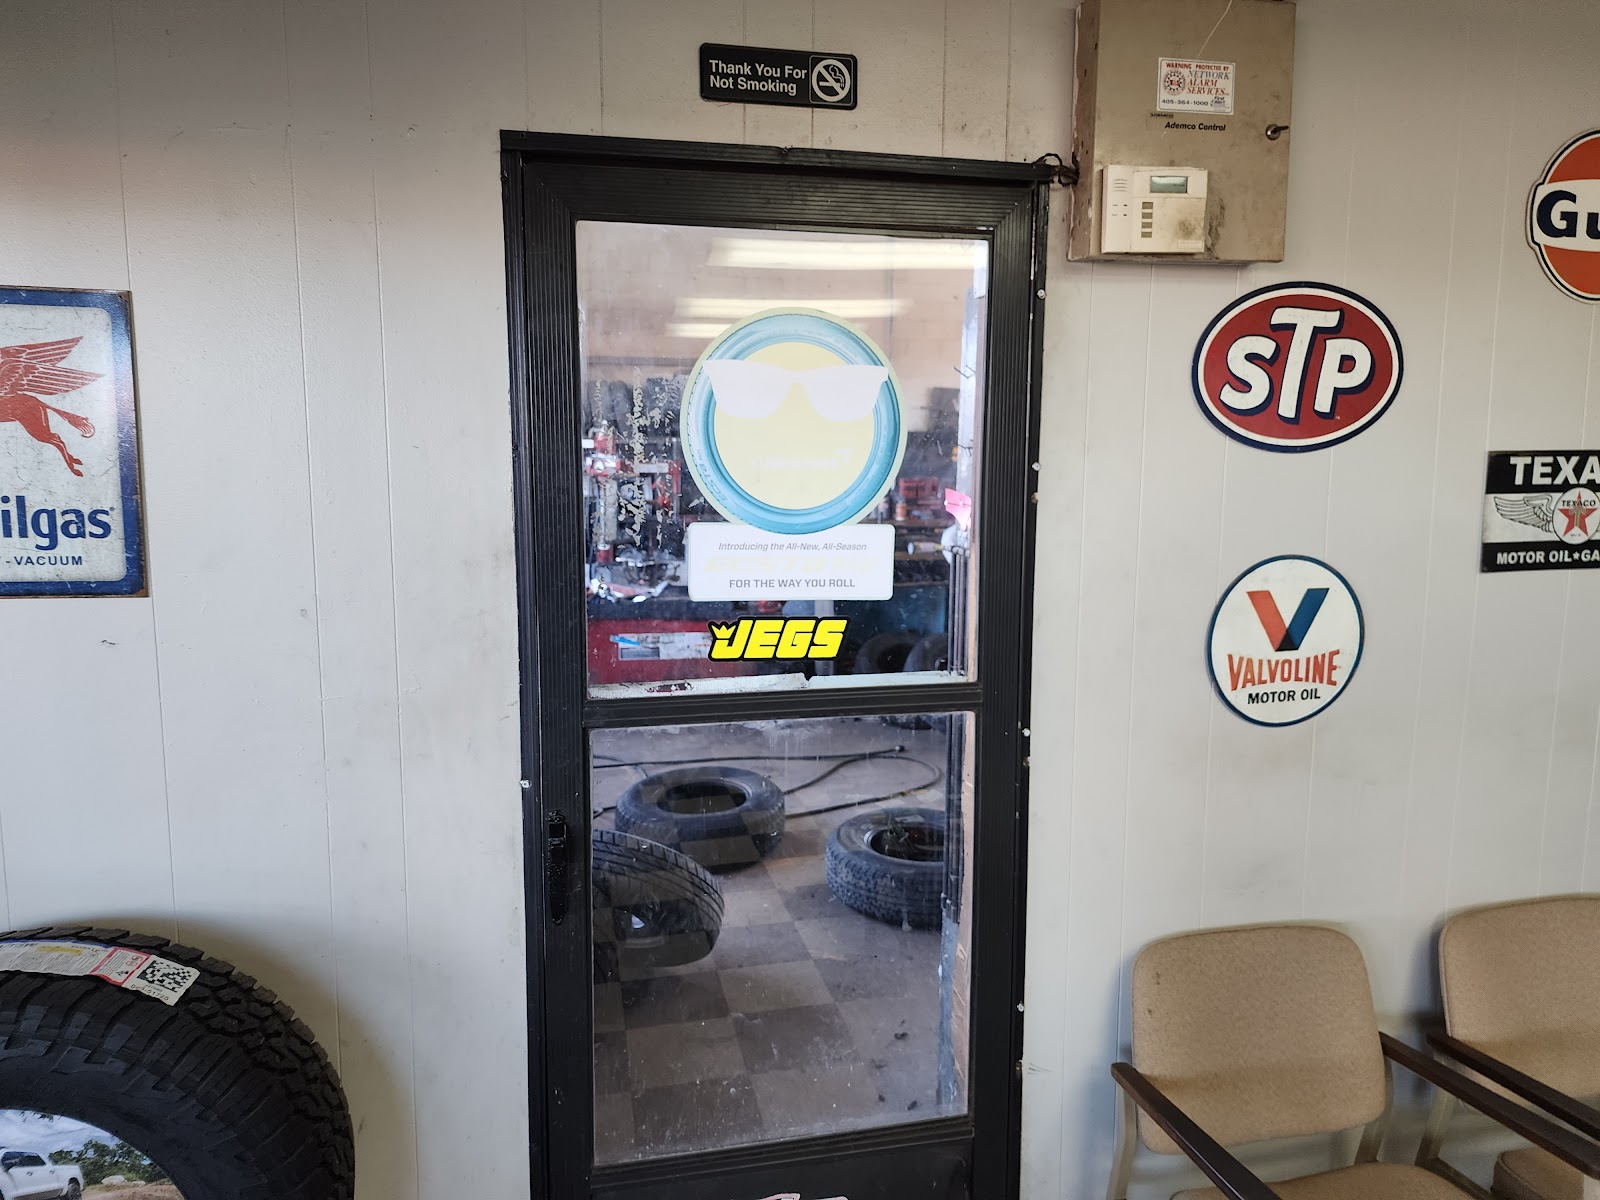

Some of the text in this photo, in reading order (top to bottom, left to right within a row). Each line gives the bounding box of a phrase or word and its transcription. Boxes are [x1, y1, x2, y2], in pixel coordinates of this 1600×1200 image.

[709, 59, 808, 79] Thank You For
[1187, 70, 1231, 80] NETWORK
[709, 74, 797, 97] Not Smoking
[1186, 79, 1218, 87] ALARM
[1186, 86, 1226, 96] SERVICES
[1164, 121, 1226, 131] Ademco Control
[1219, 306, 1375, 425] STP
[1509, 455, 1600, 486] TEXA
[718, 542, 867, 552] Introducing the All-New, All-Season
[1496, 550, 1546, 565] MOTOR
[1548, 550, 1573, 563] OIL
[729, 578, 856, 588] FOR THE WAY YOU ROLL
[709, 618, 848, 660] JEGS
[1227, 649, 1341, 692] VALVOLINE
[1247, 687, 1321, 705] MOTOR OIL
